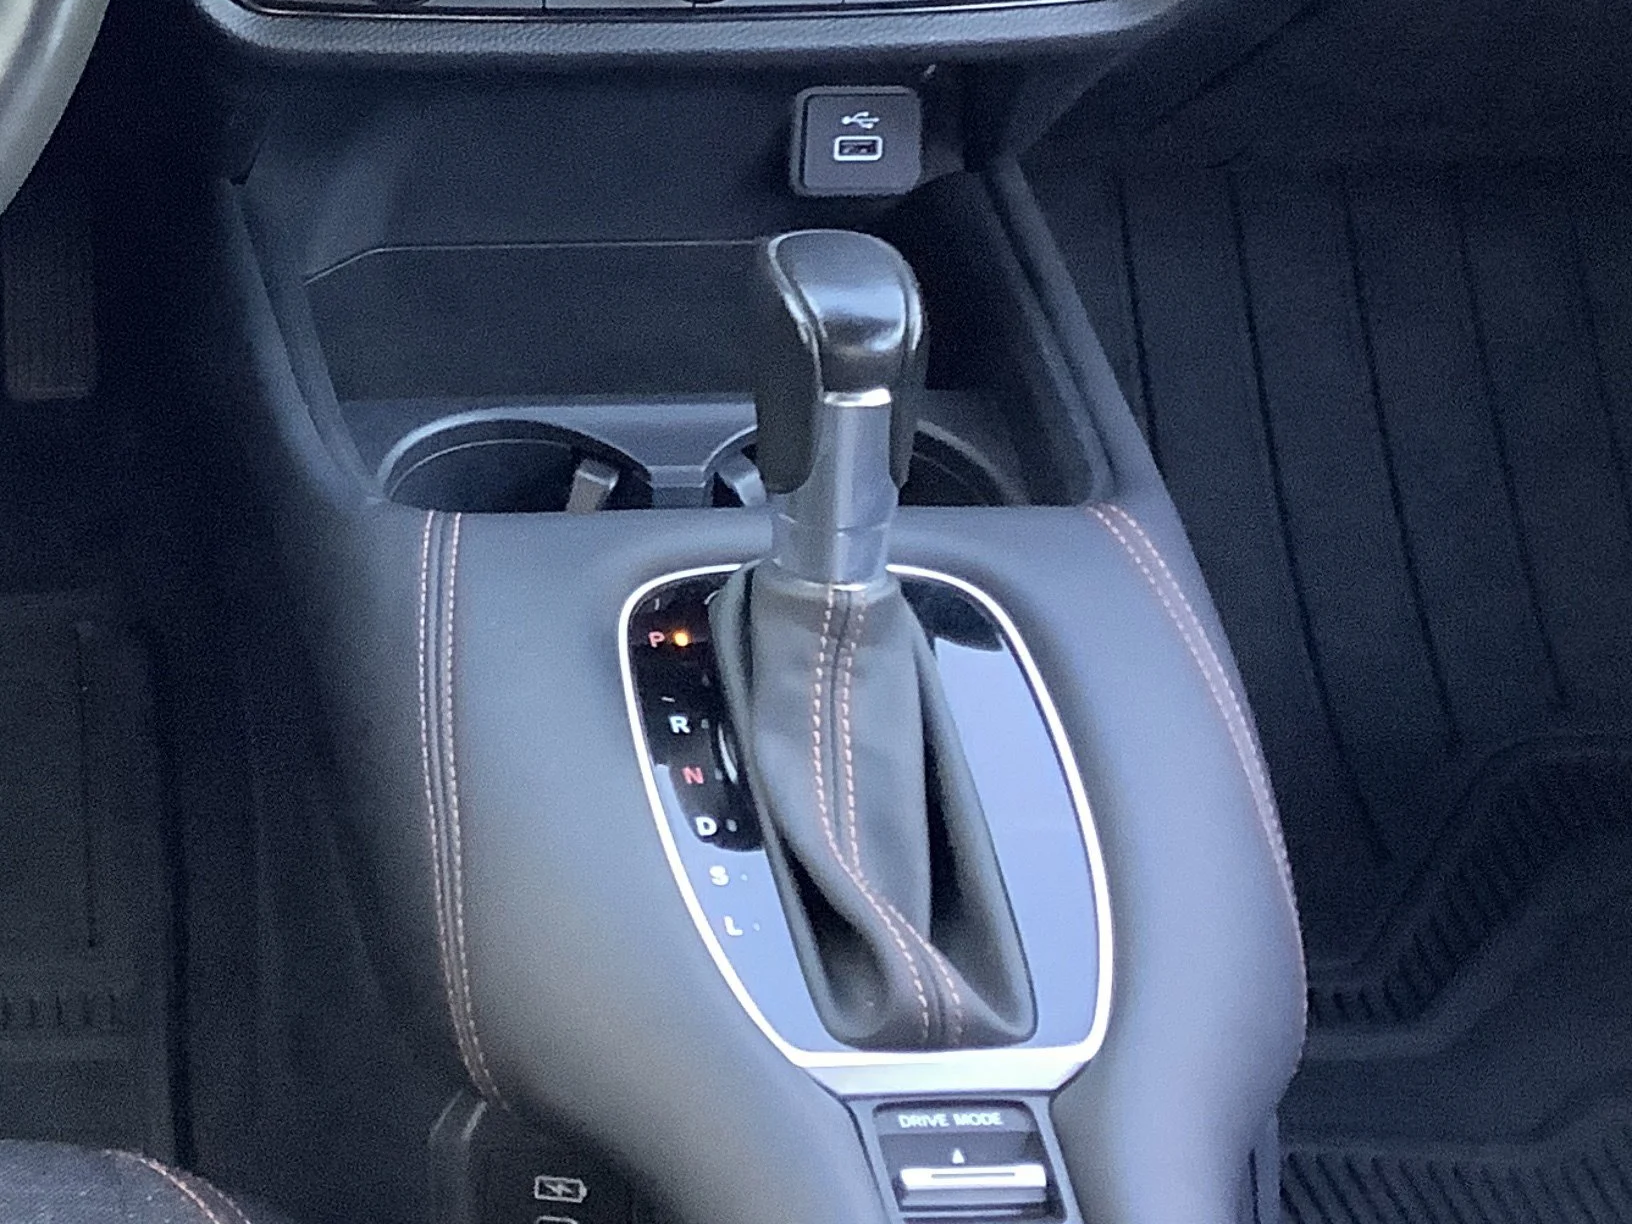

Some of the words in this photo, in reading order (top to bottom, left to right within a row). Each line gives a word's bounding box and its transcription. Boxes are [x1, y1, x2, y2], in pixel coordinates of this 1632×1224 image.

[649, 631, 665, 648] P
[670, 716, 691, 734] R
[682, 767, 704, 785] N
[695, 817, 717, 837] D
[709, 866, 729, 887] S
[723, 916, 743, 937] L
[898, 1114, 950, 1128] DRIVE
[953, 1112, 1004, 1126] MODE
